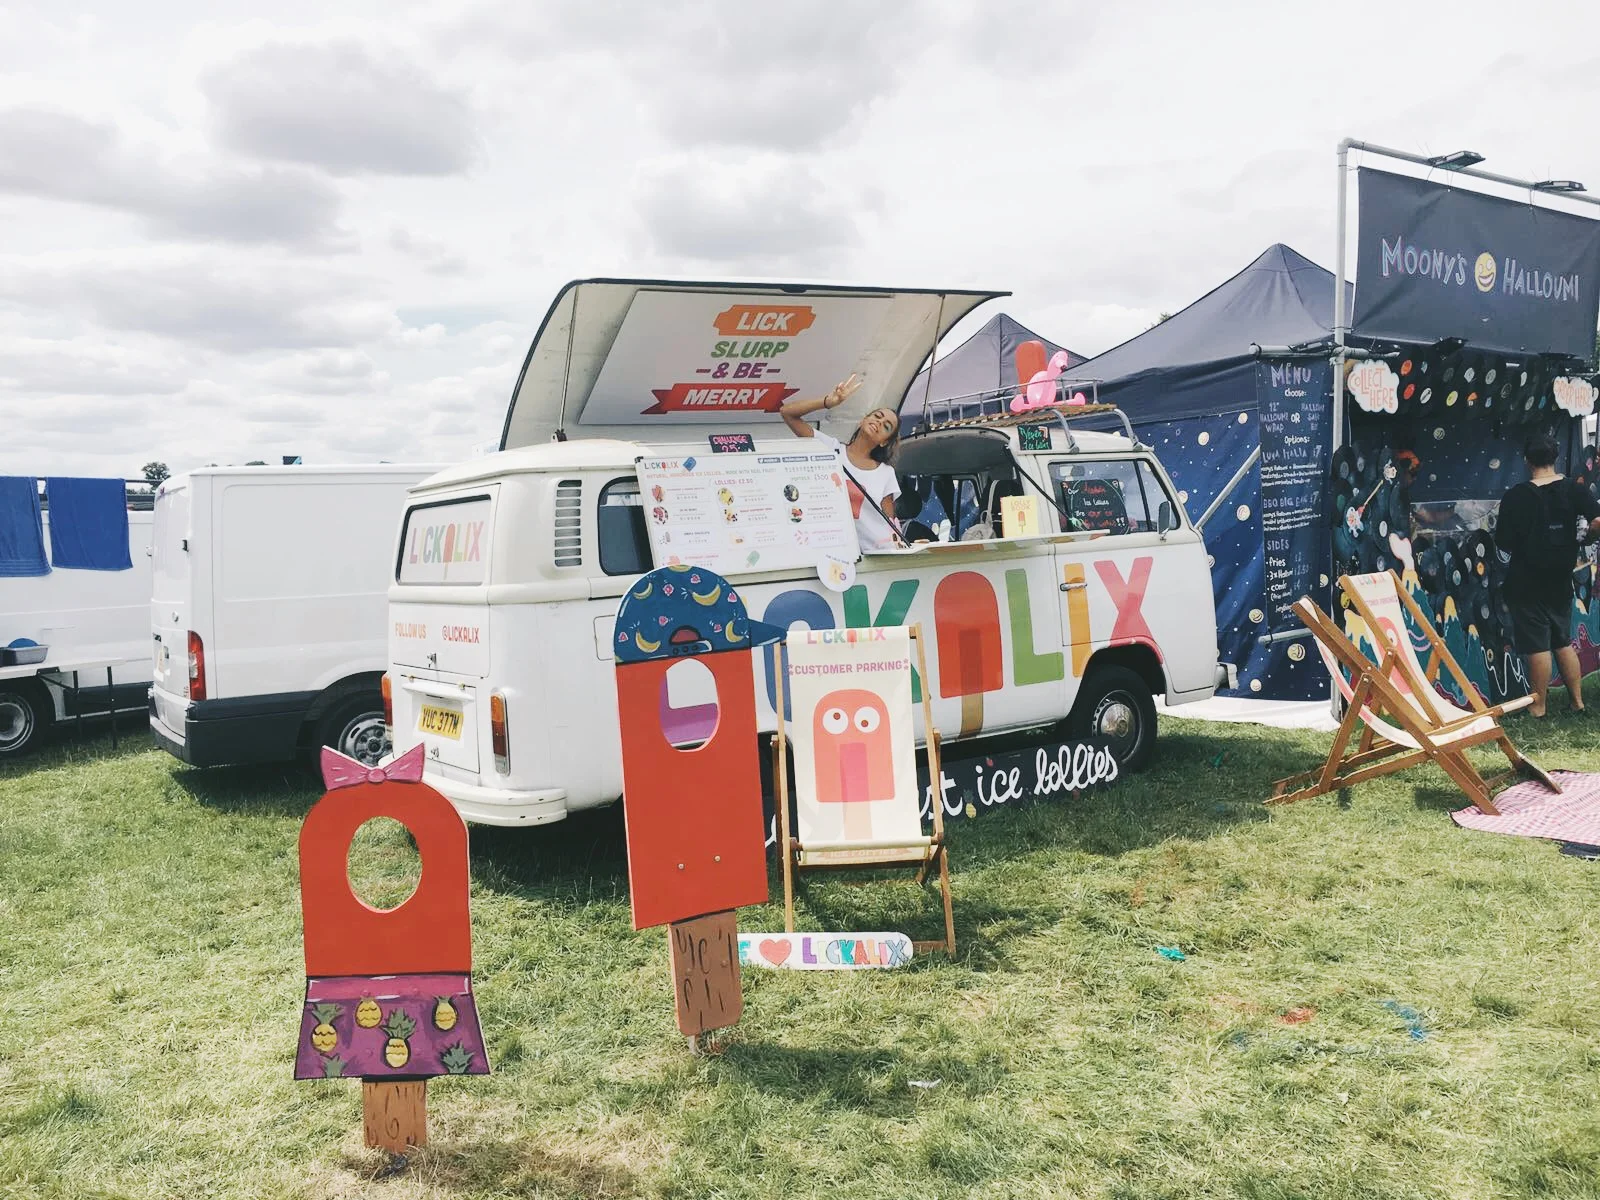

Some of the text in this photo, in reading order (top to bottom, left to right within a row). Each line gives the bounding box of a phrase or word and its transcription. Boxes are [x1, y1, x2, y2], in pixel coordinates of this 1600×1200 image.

[1382, 236, 1579, 301] MOONY'S HALLOUMI
[736, 312, 795, 332] LICK
[711, 341, 789, 359] SLURP
[1270, 362, 1312, 388] MENU
[1349, 367, 1386, 395] COLLECT
[683, 388, 769, 406] MERRY
[1370, 387, 1395, 410] HERE
[1290, 412, 1301, 424] OR
[1265, 423, 1285, 433] WRAP
[1284, 433, 1311, 446] Options:
[1267, 539, 1290, 550] SIDES
[1269, 556, 1286, 567] fries
[395, 622, 427, 639] FOLLOW US
[442, 625, 480, 643] @LICKALIX
[794, 660, 902, 676] CUSTOMER PARKING
[422, 707, 438, 729] VUC
[976, 765, 1023, 806] ice
[1034, 743, 1119, 796] lollies
[802, 937, 910, 966] LICKALIX
